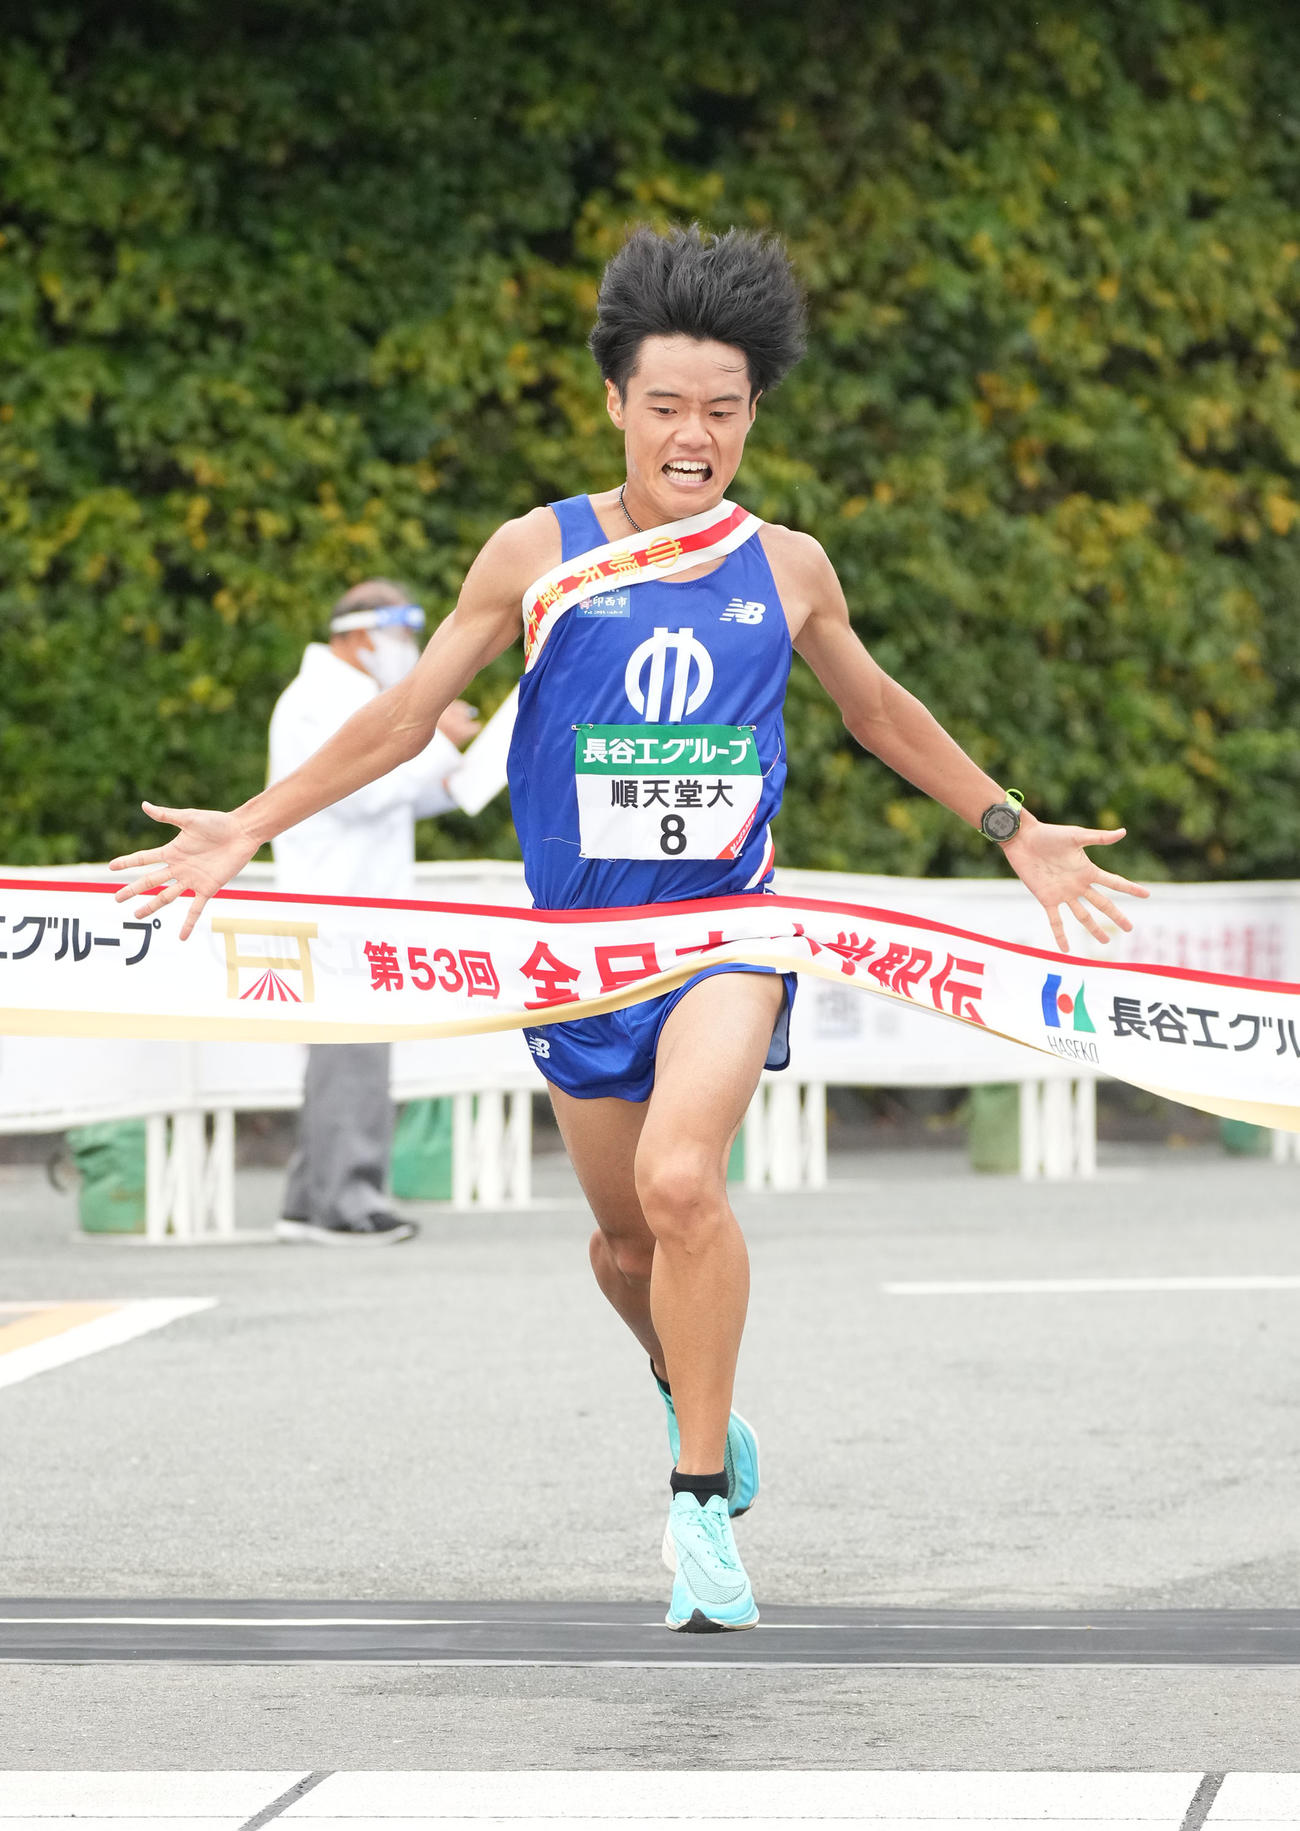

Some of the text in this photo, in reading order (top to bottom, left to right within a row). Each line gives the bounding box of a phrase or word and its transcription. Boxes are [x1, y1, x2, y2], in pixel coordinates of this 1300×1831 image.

[582, 737, 752, 765] 長谷工グループ
[610, 778, 734, 809] 順天堂大
[659, 813, 687, 856] 8
[0, 915, 162, 966] グループ
[363, 940, 501, 1000] 第53回
[519, 923, 986, 1026] 全日学駅伝
[1046, 1034, 1100, 1065] HASEKO
